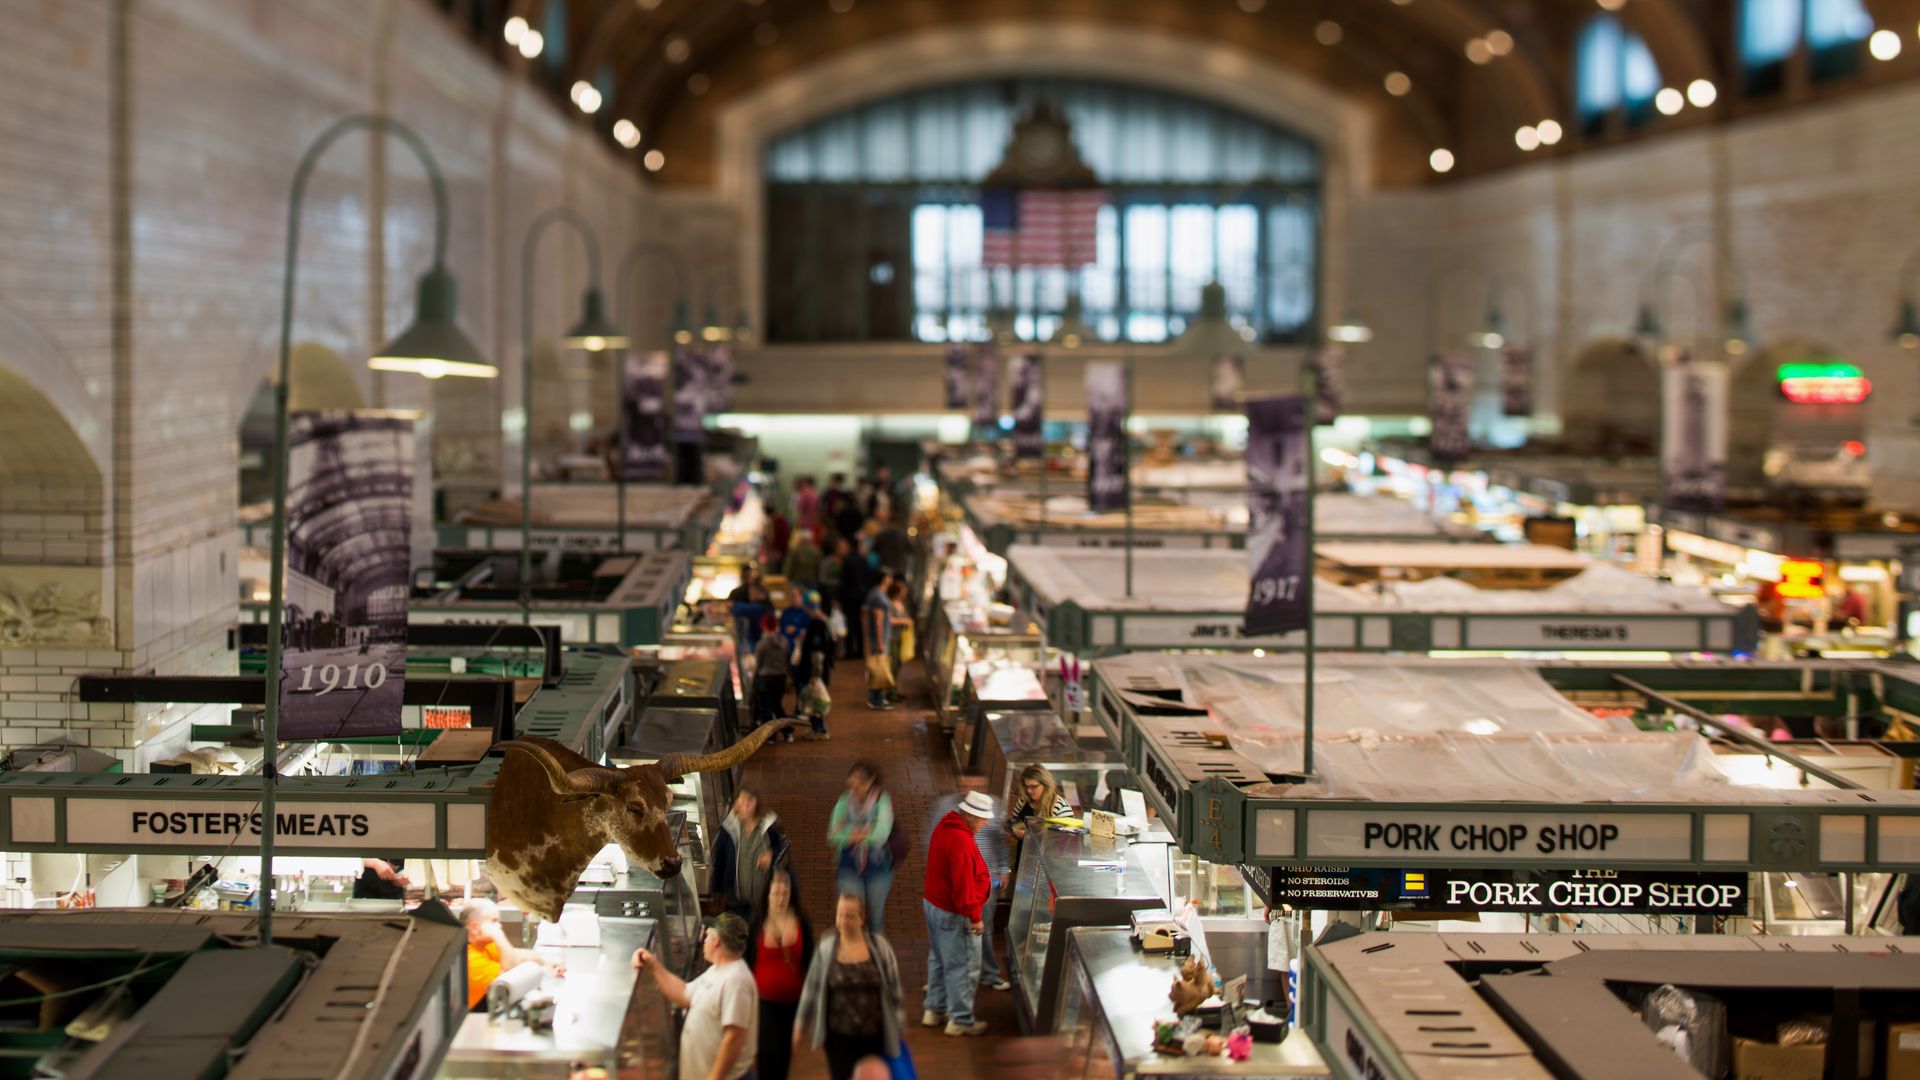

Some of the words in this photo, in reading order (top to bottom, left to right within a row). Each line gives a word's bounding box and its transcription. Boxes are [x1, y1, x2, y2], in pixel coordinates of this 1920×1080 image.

[1252, 575, 1299, 605] 1917
[297, 663, 386, 697] 1910
[132, 811, 263, 835] FOSTER'S
[275, 813, 370, 837] MEATS
[1364, 822, 1441, 851] PORK
[1450, 824, 1528, 853] CHOP
[1536, 823, 1619, 854] SHOP
[1287, 877, 1301, 885] NO
[1302, 877, 1350, 885] STEROIDS
[1287, 890, 1301, 898] NO
[1302, 890, 1379, 898] PRESERVATIVES
[1446, 880, 1541, 905] PORK
[1548, 881, 1643, 907] CHOP
[1648, 883, 1741, 908] SHOP
